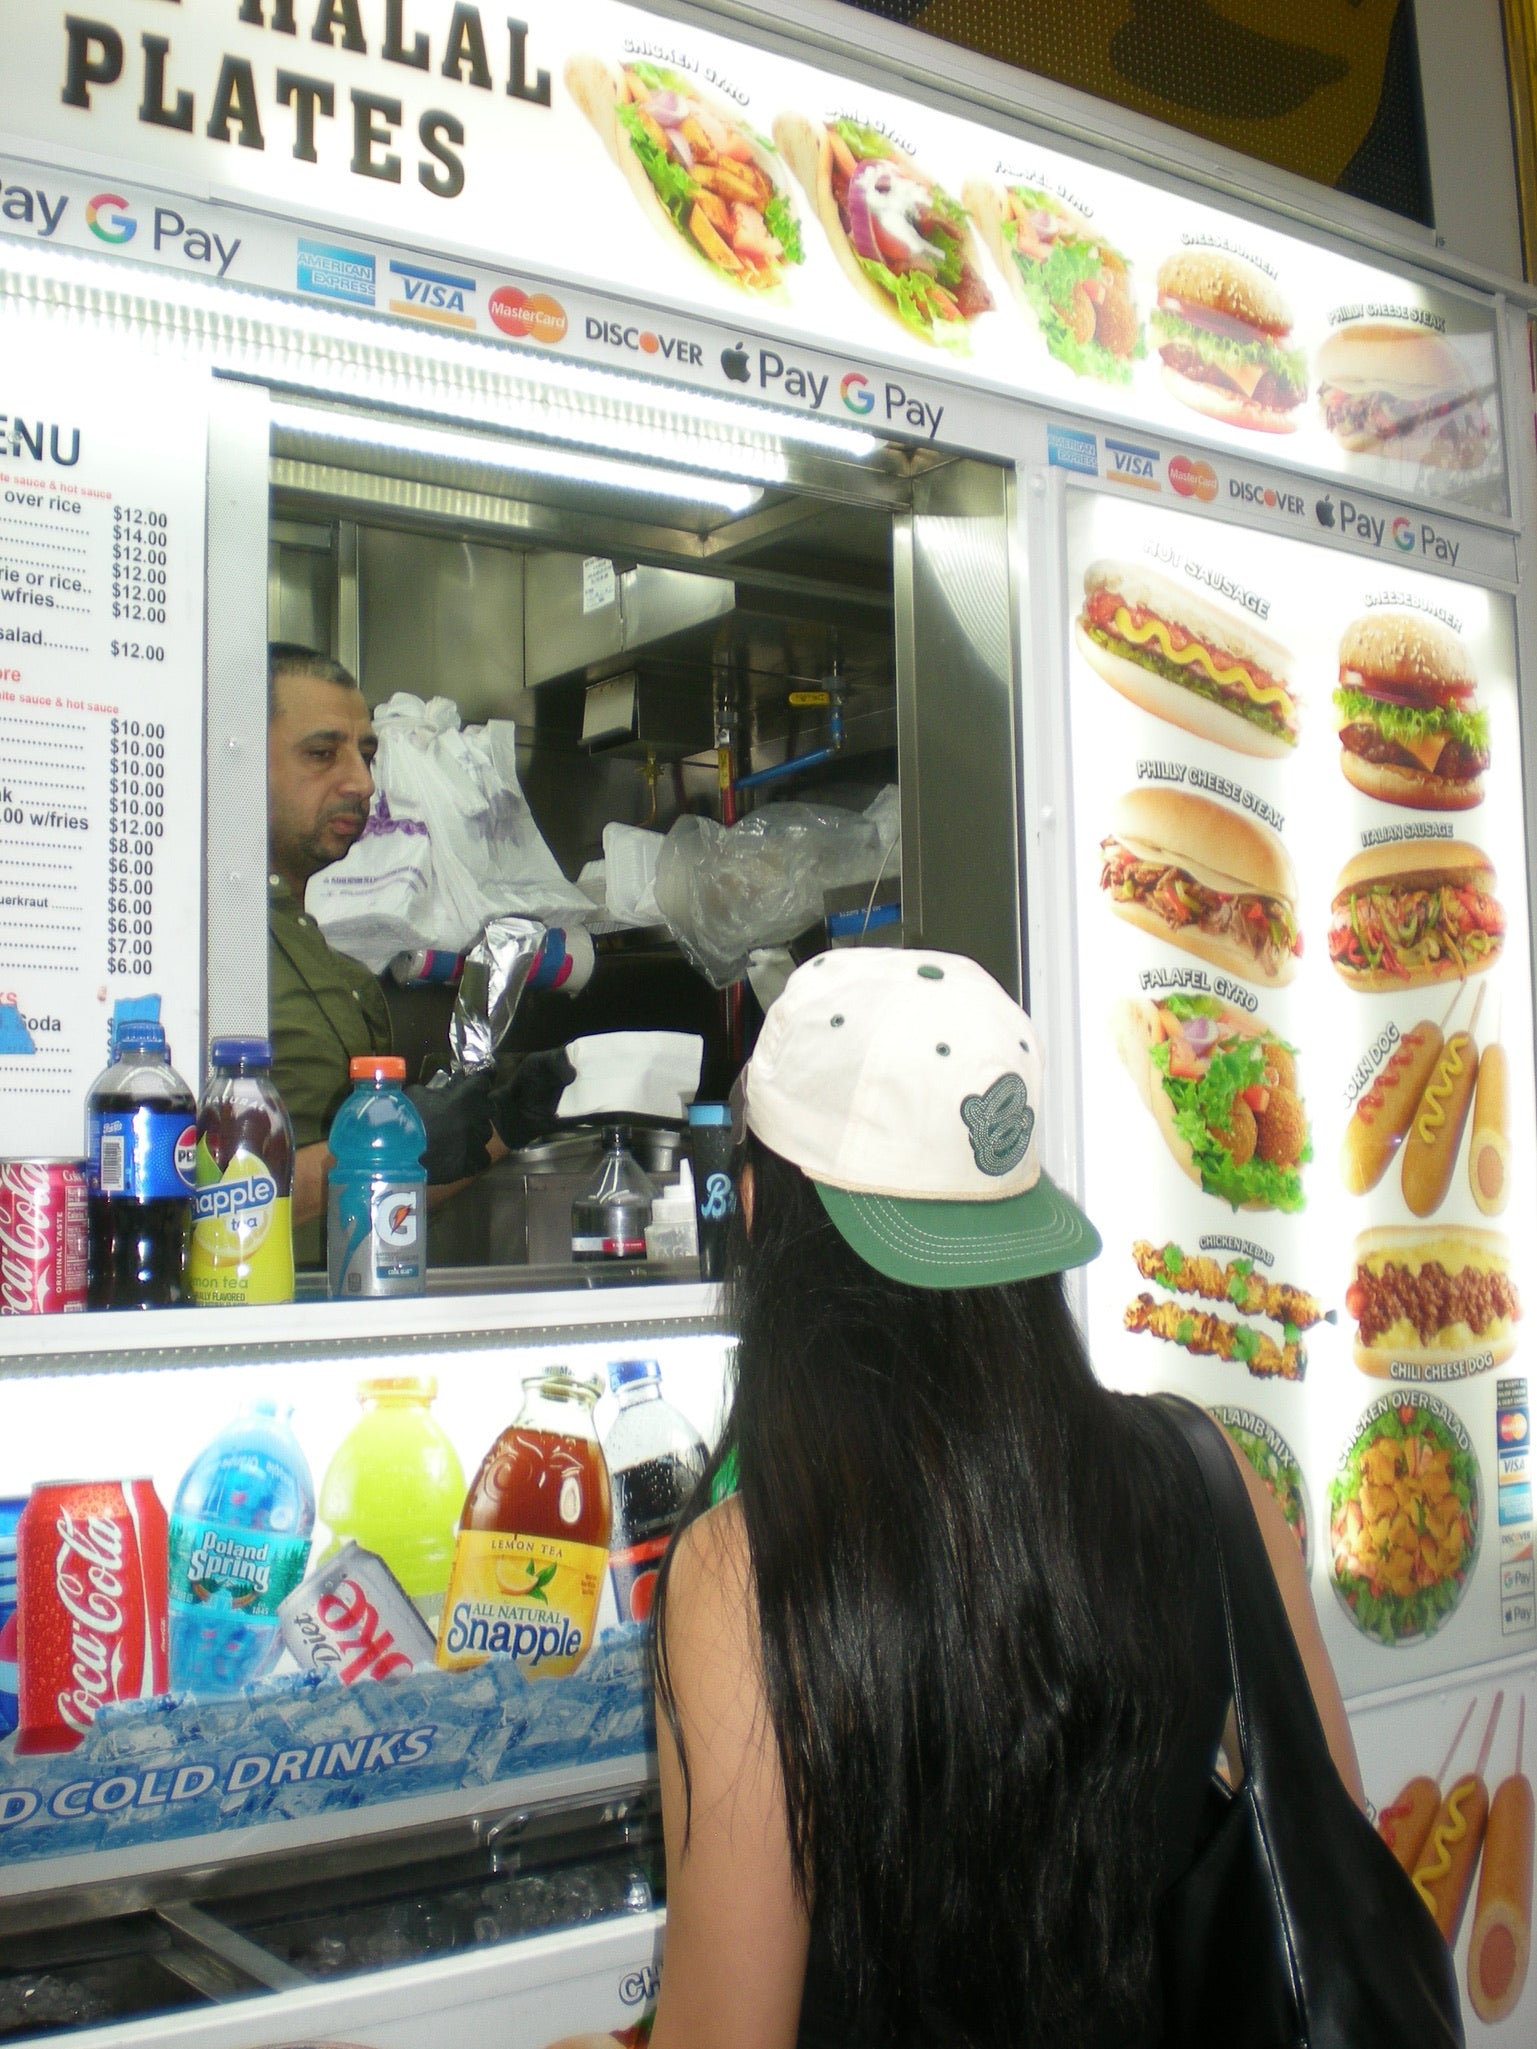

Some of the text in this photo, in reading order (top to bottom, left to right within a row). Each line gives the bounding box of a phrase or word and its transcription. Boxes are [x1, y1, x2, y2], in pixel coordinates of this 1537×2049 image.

[622, 38, 750, 107] CHICKEN GYRO
[61, 14, 466, 199] PLATES
[874, 119, 917, 156] GYRO
[1056, 184, 1094, 218] GYRO
[0, 178, 69, 236] ay
[154, 207, 241, 277] Pay
[298, 252, 372, 281] AMERICAN
[313, 270, 375, 296] EXPRESS
[403, 278, 464, 312] VISA
[491, 301, 566, 328] MasterCard
[1326, 302, 1446, 333] PHILLY CHEESE STEAK
[585, 316, 703, 366] DISCOVER
[759, 349, 829, 409] Pay
[885, 383, 944, 438] Pay
[1114, 452, 1153, 478] VISA
[1170, 468, 1217, 488] MasterCard
[13, 475, 46, 488] sauce
[49, 480, 57, 490] &
[60, 482, 78, 494] hot
[80, 487, 112, 500] sauce
[1229, 478, 1305, 516] DISCOVER
[4, 490, 168, 529] over rice $12.00
[1340, 500, 1385, 547] Pay
[112, 524, 167, 548] $14.00
[1421, 525, 1460, 567] Pay
[112, 543, 167, 567] $12.00
[26, 571, 44, 586] or
[112, 581, 167, 605] $12.00
[112, 562, 167, 586] $12.00
[1184, 559, 1270, 621] SAUSAGE
[111, 601, 166, 624] $12.00
[110, 639, 165, 662] $12.00
[0, 667, 21, 682] re
[0, 689, 119, 714] ite sauce & hot sauce
[110, 717, 165, 740] $10.00
[110, 737, 165, 760] $10.00
[110, 757, 164, 779] $10.00
[109, 777, 164, 798] $10.00
[1136, 759, 1285, 832] PHILLY CHEESE STEAK
[109, 796, 164, 818] $10.00
[30, 810, 89, 831] w/fries
[109, 816, 164, 837] $12.00
[1361, 822, 1454, 848] ITALIAN SAUSAGE
[108, 836, 154, 857] $8.00
[108, 856, 154, 877] $6.00
[108, 876, 153, 896] $5.00
[107, 896, 153, 916] $6.00
[107, 916, 153, 936] $6.00
[107, 936, 153, 956] $7.00
[107, 956, 152, 976] $6.00
[1139, 967, 1259, 1013] FALAFEL GYRO
[1369, 1021, 1400, 1067] DOG
[193, 1178, 271, 1219] apple
[55, 1211, 63, 1294] ORIGINAL TASTE
[1198, 1234, 1275, 1267] CHICKEN KEBAB
[191, 1275, 248, 1289] mon tea
[1390, 1352, 1494, 1381] CHILI CHEESE DOG
[1222, 1407, 1294, 1468] LAMB MIX
[1337, 1391, 1470, 1472] CHICKEN OVER SALAD
[1503, 1459, 1525, 1474] VISA
[201, 1530, 269, 1561] Poland
[490, 1537, 564, 1558] LEMON TEA
[187, 1549, 271, 1593] Spring
[56, 1504, 124, 1735] Coca-Cola
[471, 1602, 564, 1625] ALL NATURAL
[1514, 1605, 1531, 1622] Pay
[293, 1612, 341, 1668] Diet
[316, 1577, 413, 1687] ke
[446, 1602, 582, 1667] Snapple
[48, 1761, 219, 1820] COLD
[223, 1725, 439, 1795] DRINKS
